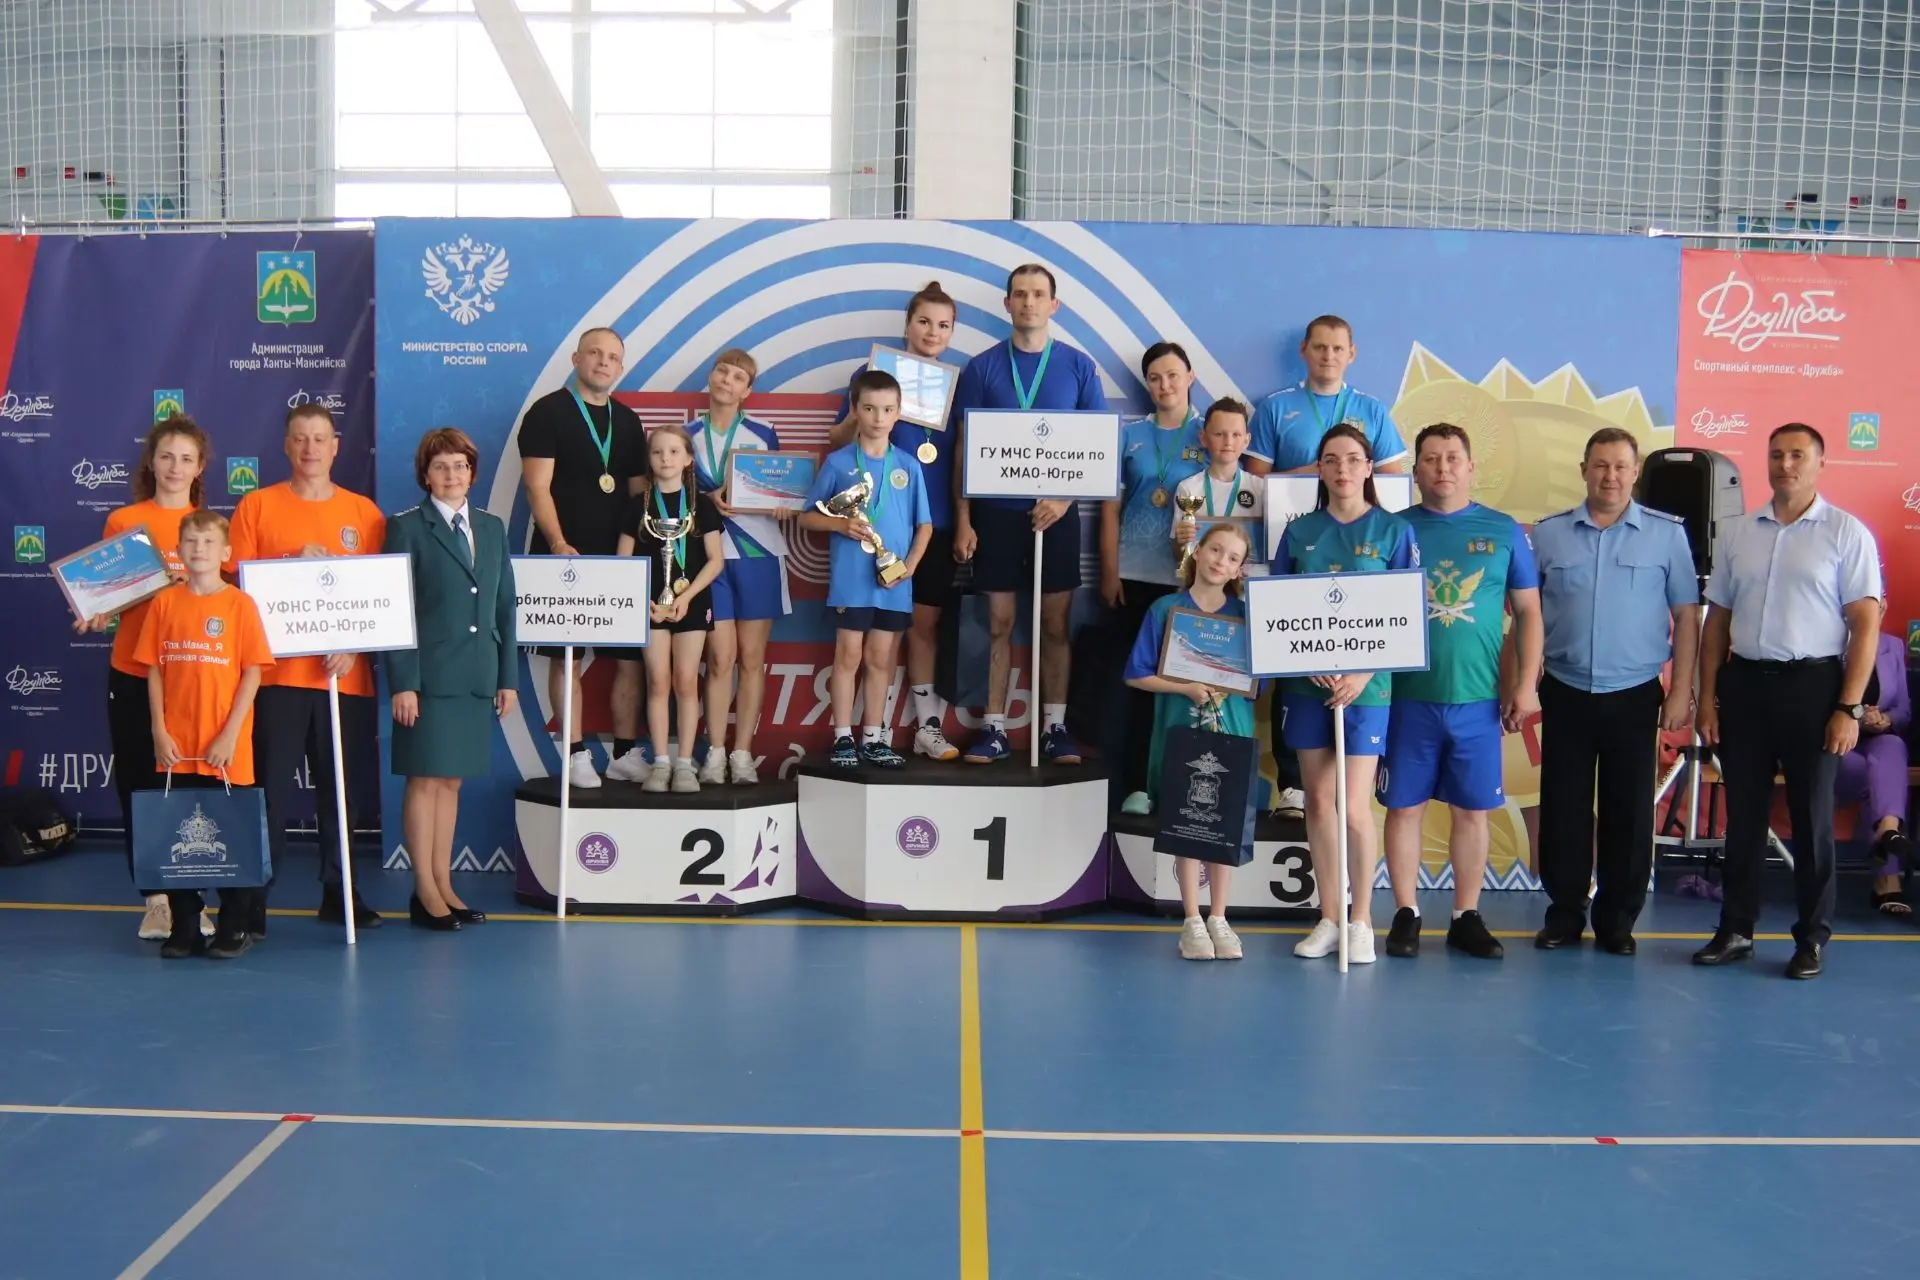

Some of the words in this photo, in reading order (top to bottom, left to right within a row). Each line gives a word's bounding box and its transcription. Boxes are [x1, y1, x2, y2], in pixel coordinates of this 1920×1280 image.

[1697, 270, 1847, 352] Дружба
[251, 342, 324, 356] Администрация
[402, 342, 484, 353] МИНИСТЕРСТВО
[486, 342, 528, 353] СПОРТА
[229, 359, 261, 371] города
[263, 357, 346, 369] Ханты-Мансийска
[443, 356, 487, 365] РОССИИ
[1694, 359, 1749, 373] Спортивный
[1751, 363, 1796, 375] комплекс
[1691, 407, 1749, 439] Дружба
[980, 447, 997, 459] ГУ
[1001, 447, 1032, 459] МЧС
[1036, 447, 1084, 460] России
[1088, 450, 1105, 460] по
[72, 458, 130, 489] Дружба
[1000, 466, 1084, 481] ХМАО-Югре
[266, 600, 311, 614] УФНС
[315, 598, 369, 611] России
[373, 597, 391, 609] по
[516, 593, 606, 608] рбитражный
[610, 596, 634, 609] суд
[285, 618, 376, 635] ХМАО-Югре
[525, 613, 613, 628] ХМАО-Югры
[1266, 617, 1323, 632] УФССП
[1328, 616, 1384, 630] России
[1389, 615, 1408, 627] по
[1290, 636, 1386, 654] ХМАО-Югре
[5, 664, 63, 696] Дружба
[679, 828, 725, 886] 2
[973, 816, 1007, 881] 1
[1269, 846, 1316, 903] 3
